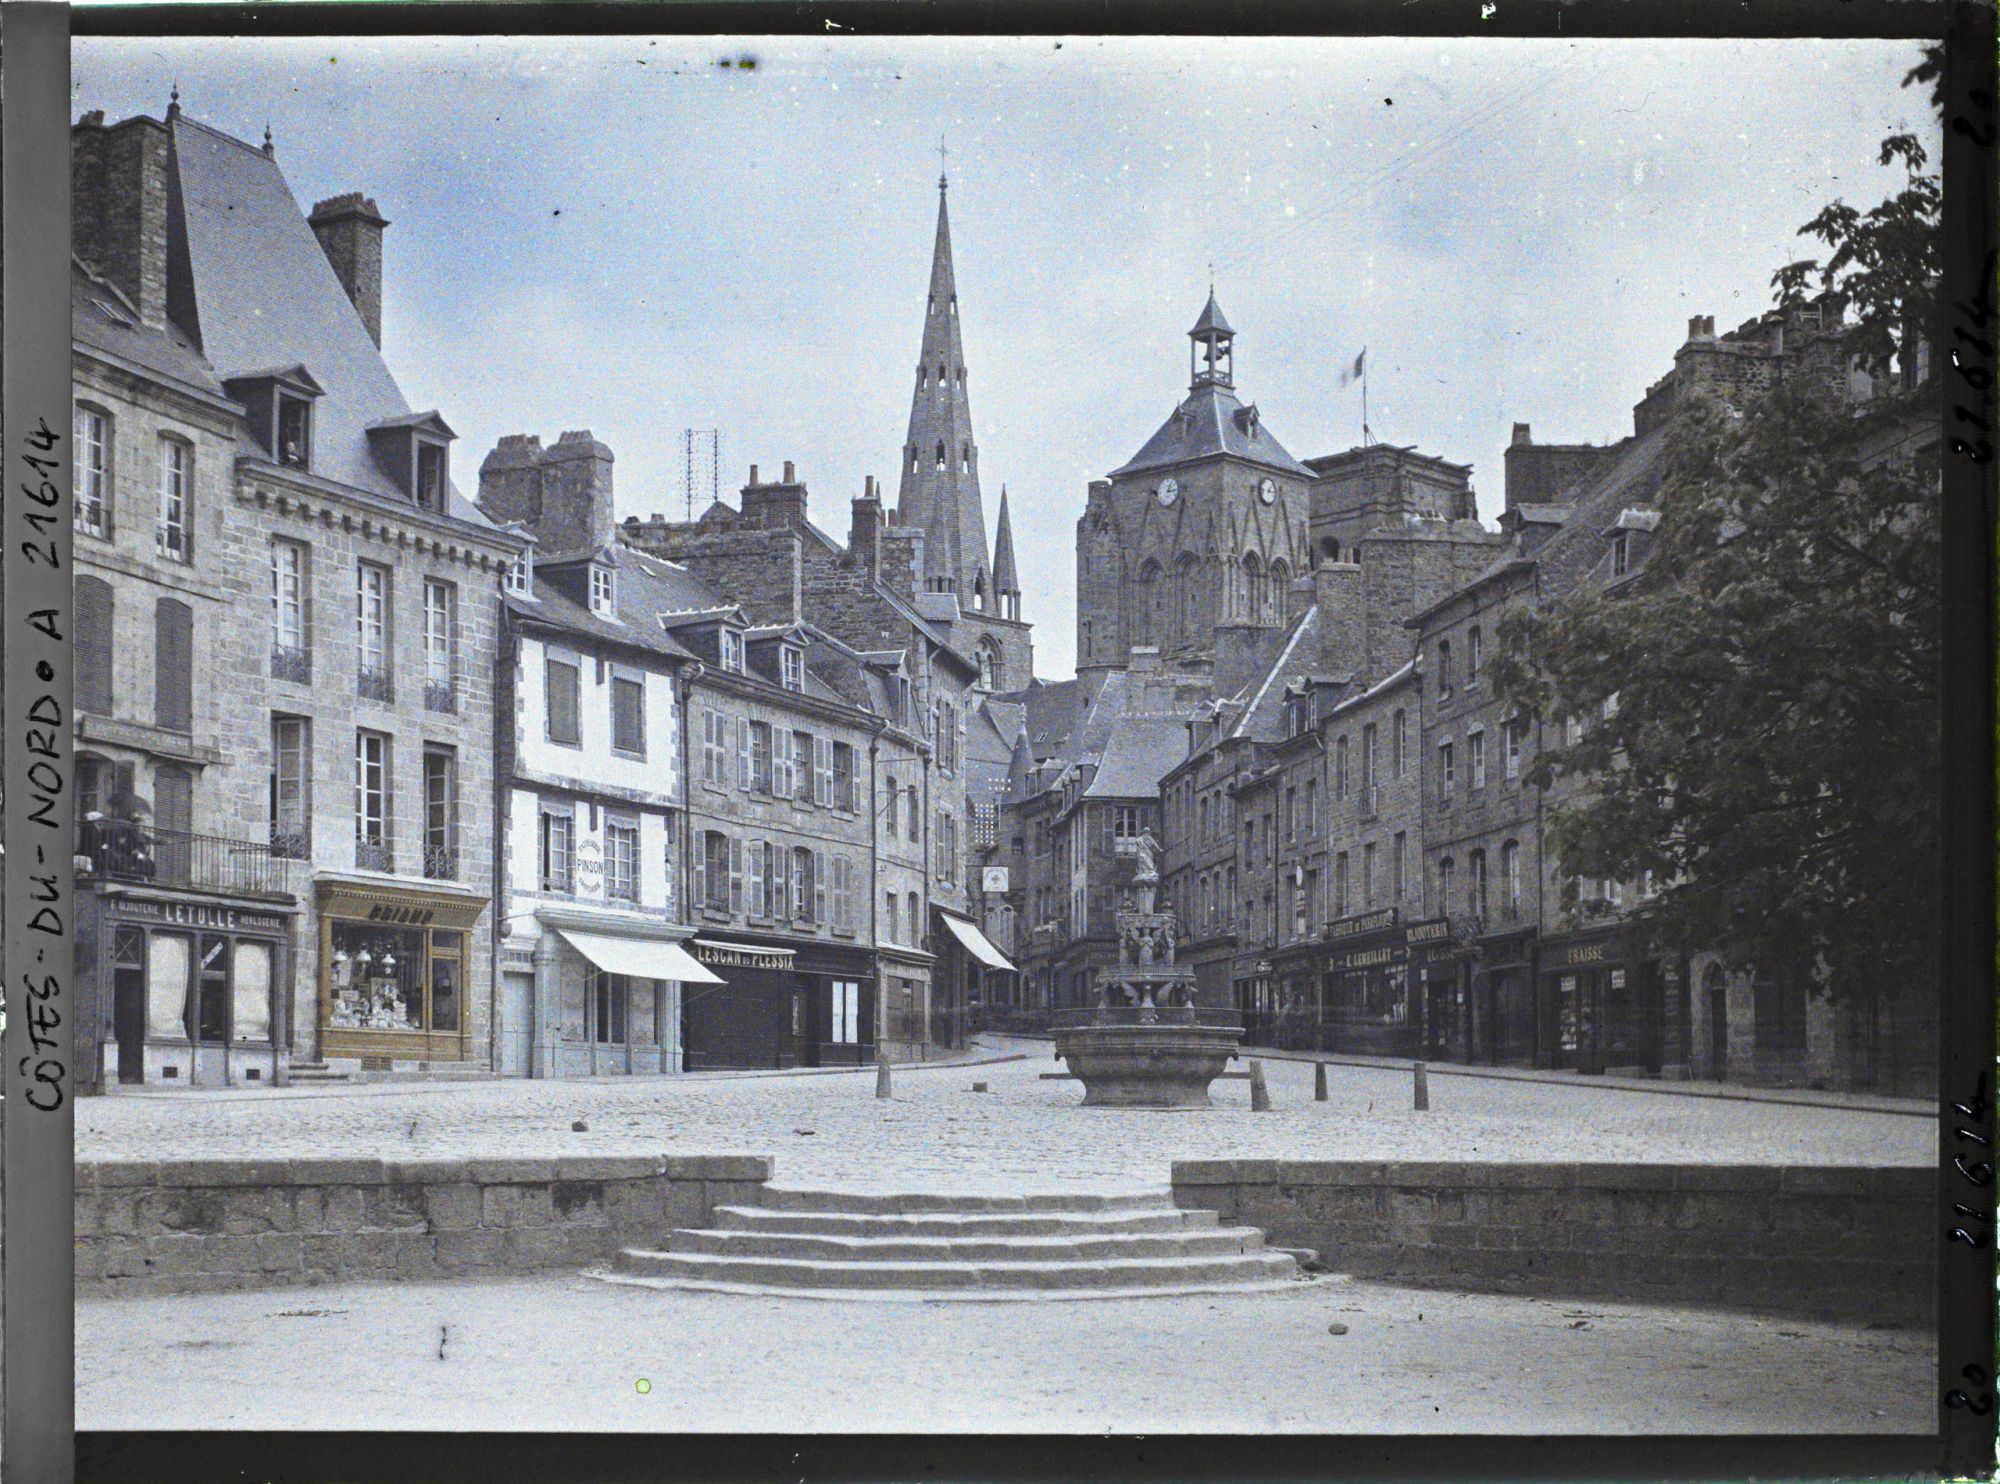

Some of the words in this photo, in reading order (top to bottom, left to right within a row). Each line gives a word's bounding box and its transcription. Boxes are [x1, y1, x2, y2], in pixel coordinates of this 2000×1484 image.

[21, 417, 60, 568] 21614
[577, 858, 603, 874] PINSON
[118, 900, 159, 915] BIJOUTERIE
[165, 903, 235, 928] LETULLE
[240, 915, 282, 929] HORLOGERIE
[752, 954, 794, 970] PLESSIX
[1568, 945, 1604, 964] FRAISSE
